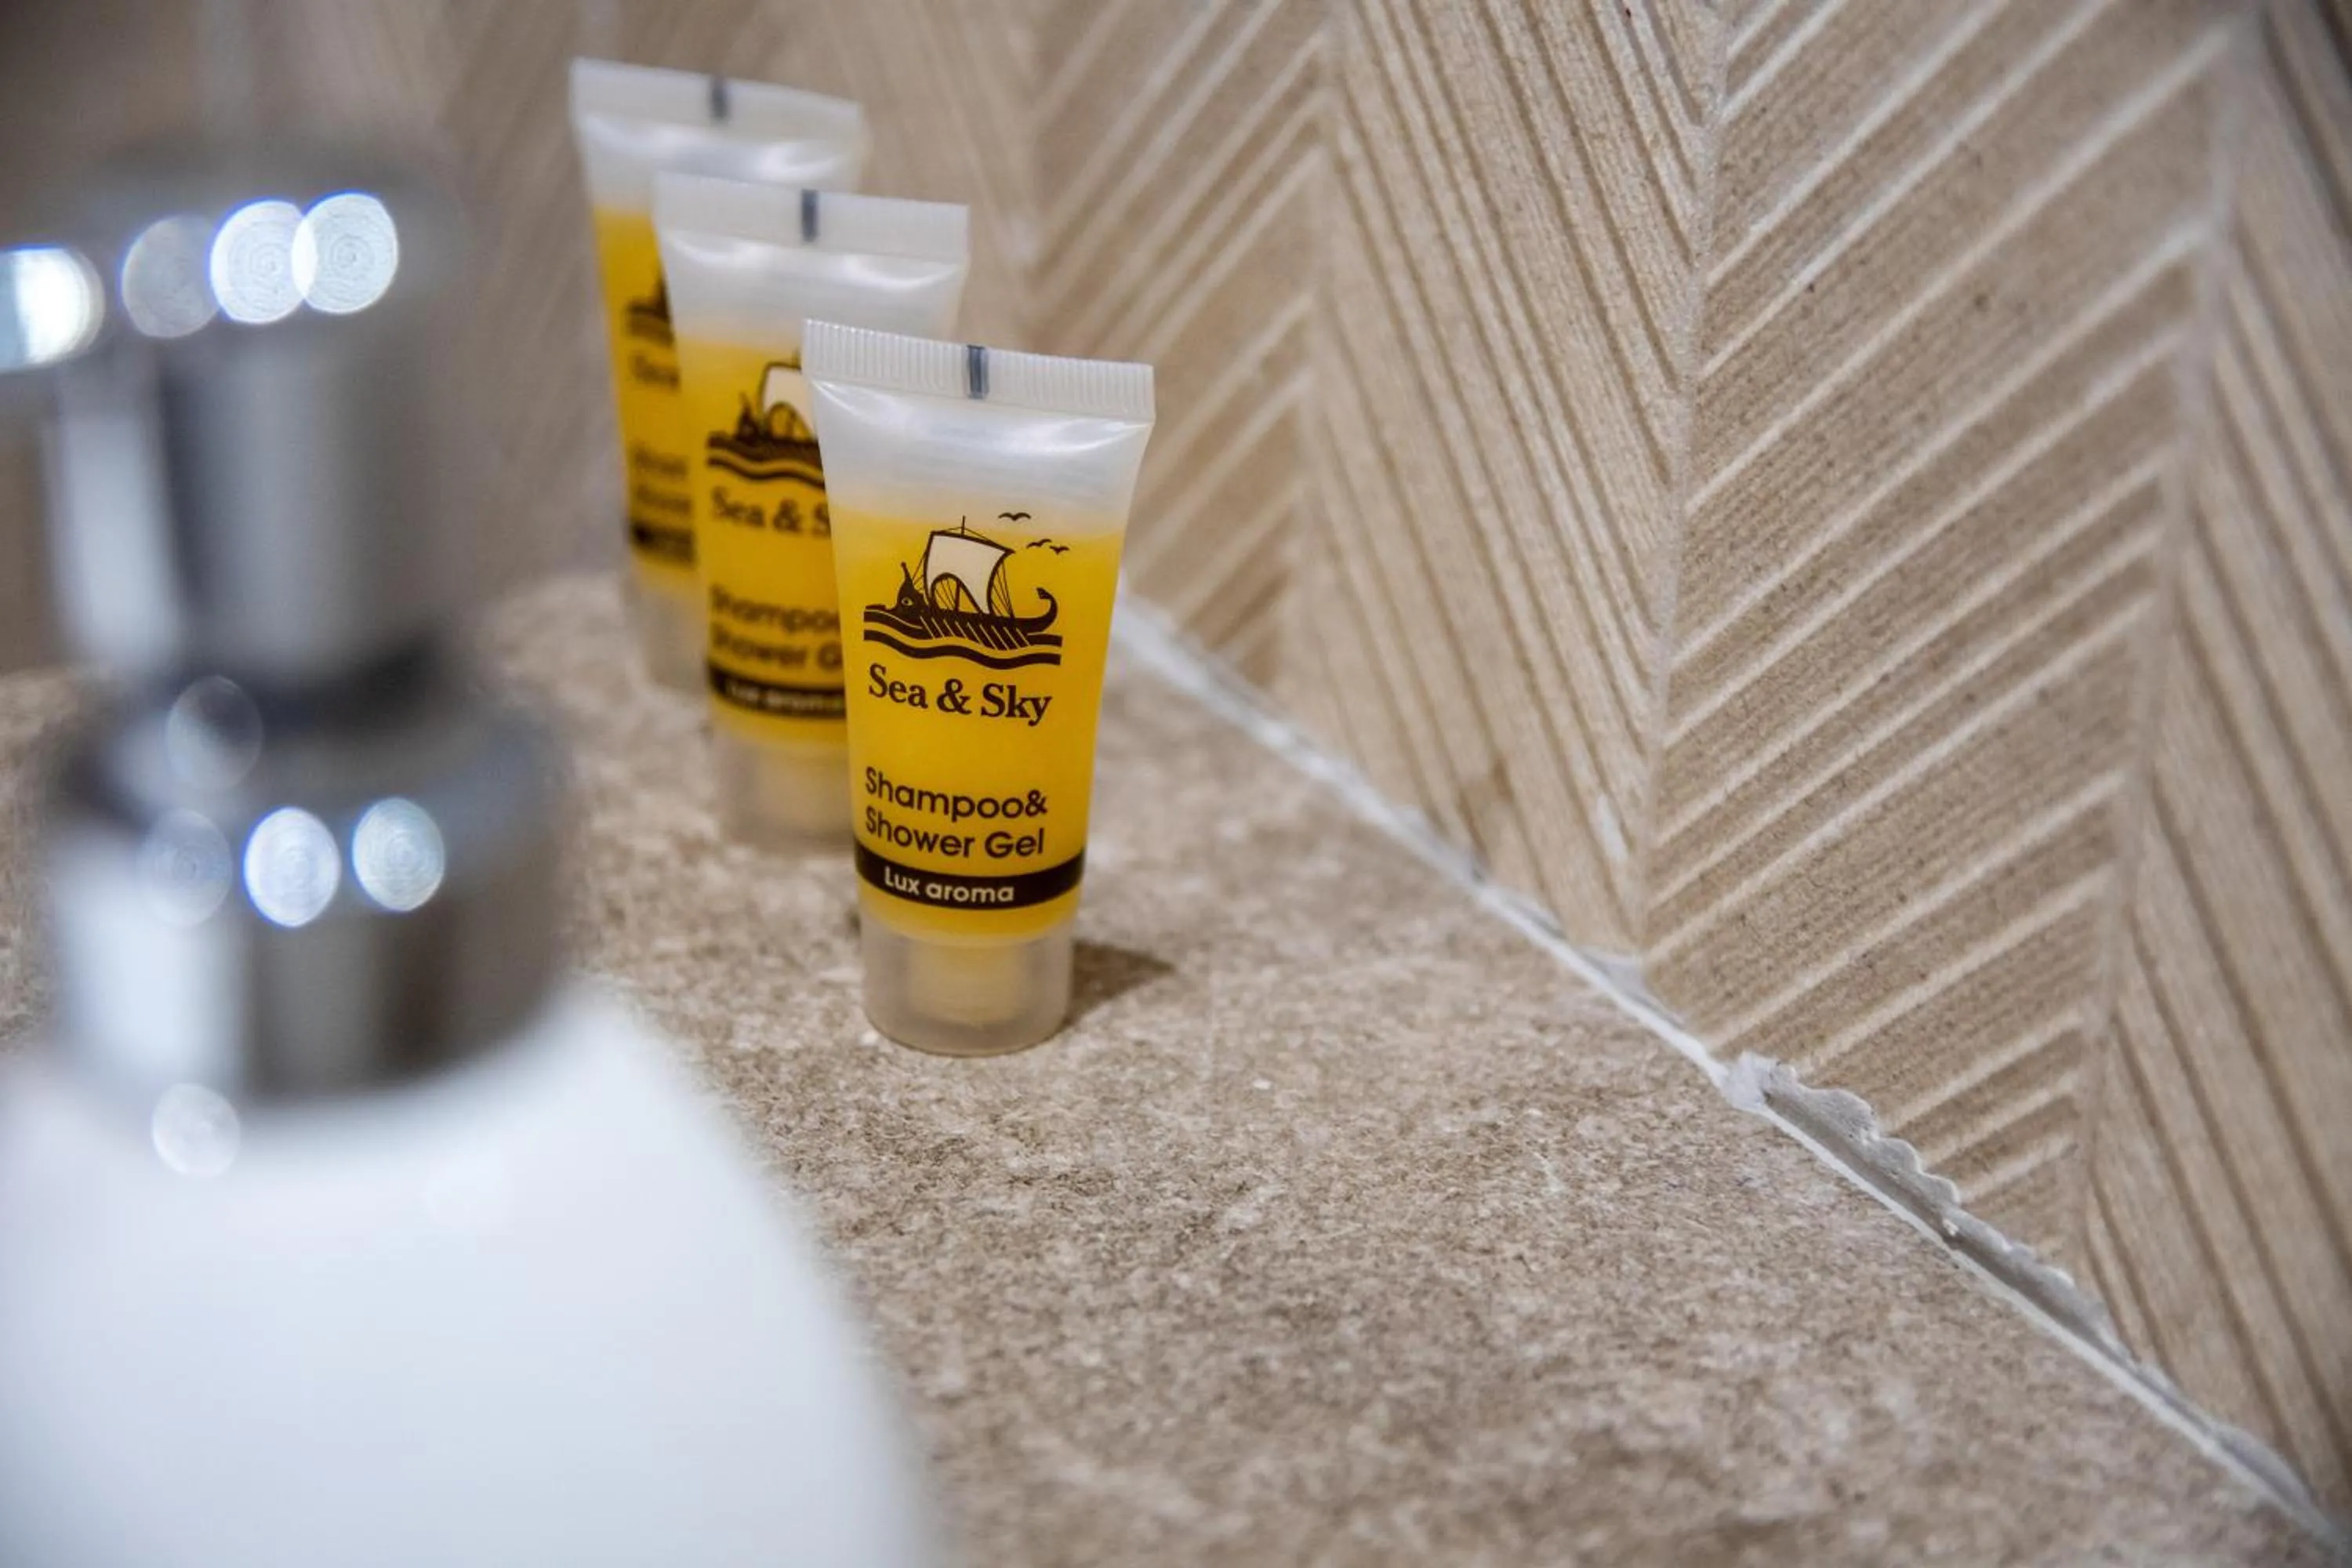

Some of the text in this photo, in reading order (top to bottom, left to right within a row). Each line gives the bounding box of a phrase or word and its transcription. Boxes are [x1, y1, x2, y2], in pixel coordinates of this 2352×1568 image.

[773, 499, 802, 532] &
[868, 662, 1052, 726] Sea & Sky
[865, 766, 1047, 822] Shampoo&
[865, 806, 1044, 858] Shower Gel
[884, 866, 1014, 902] Lux aroma
